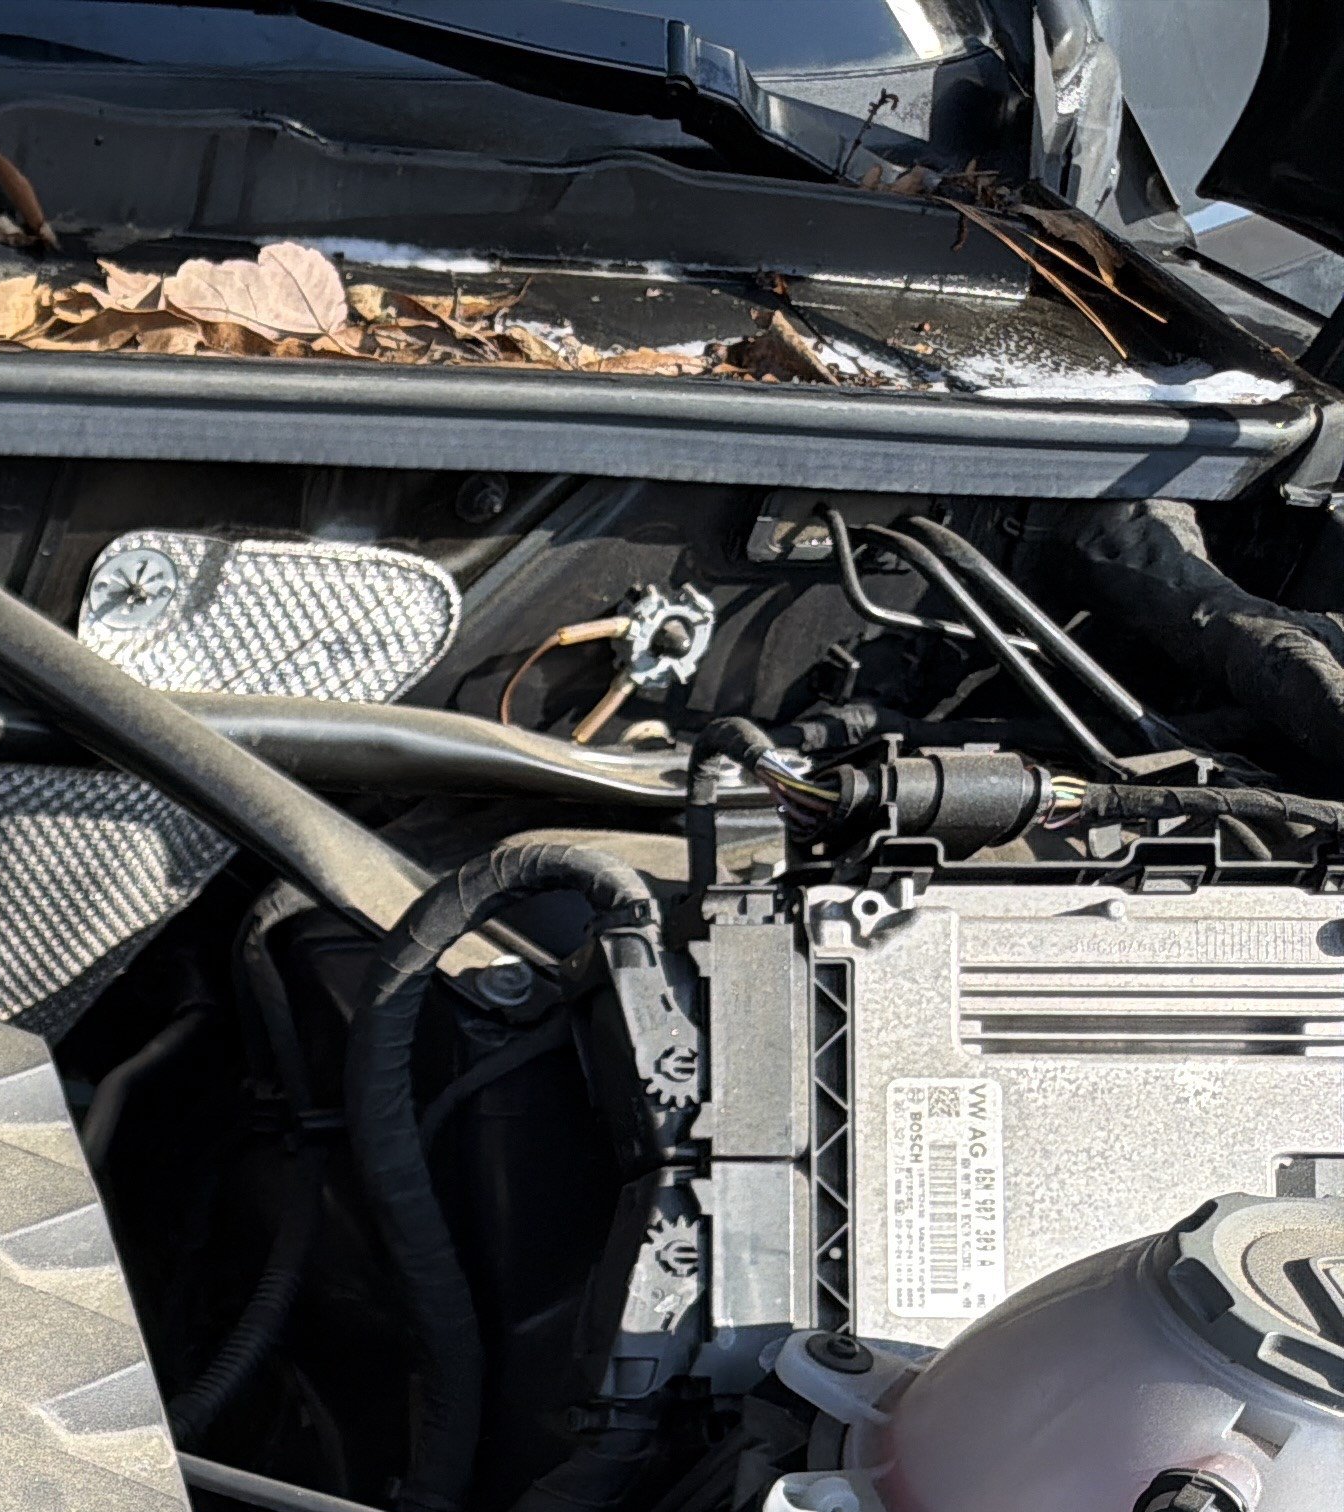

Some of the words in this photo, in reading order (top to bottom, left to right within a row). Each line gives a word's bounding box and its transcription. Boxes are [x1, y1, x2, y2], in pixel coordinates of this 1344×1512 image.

[968, 1084, 988, 1121] VW
[909, 1111, 924, 1164] BOSCH
[968, 1127, 988, 1159] AG
